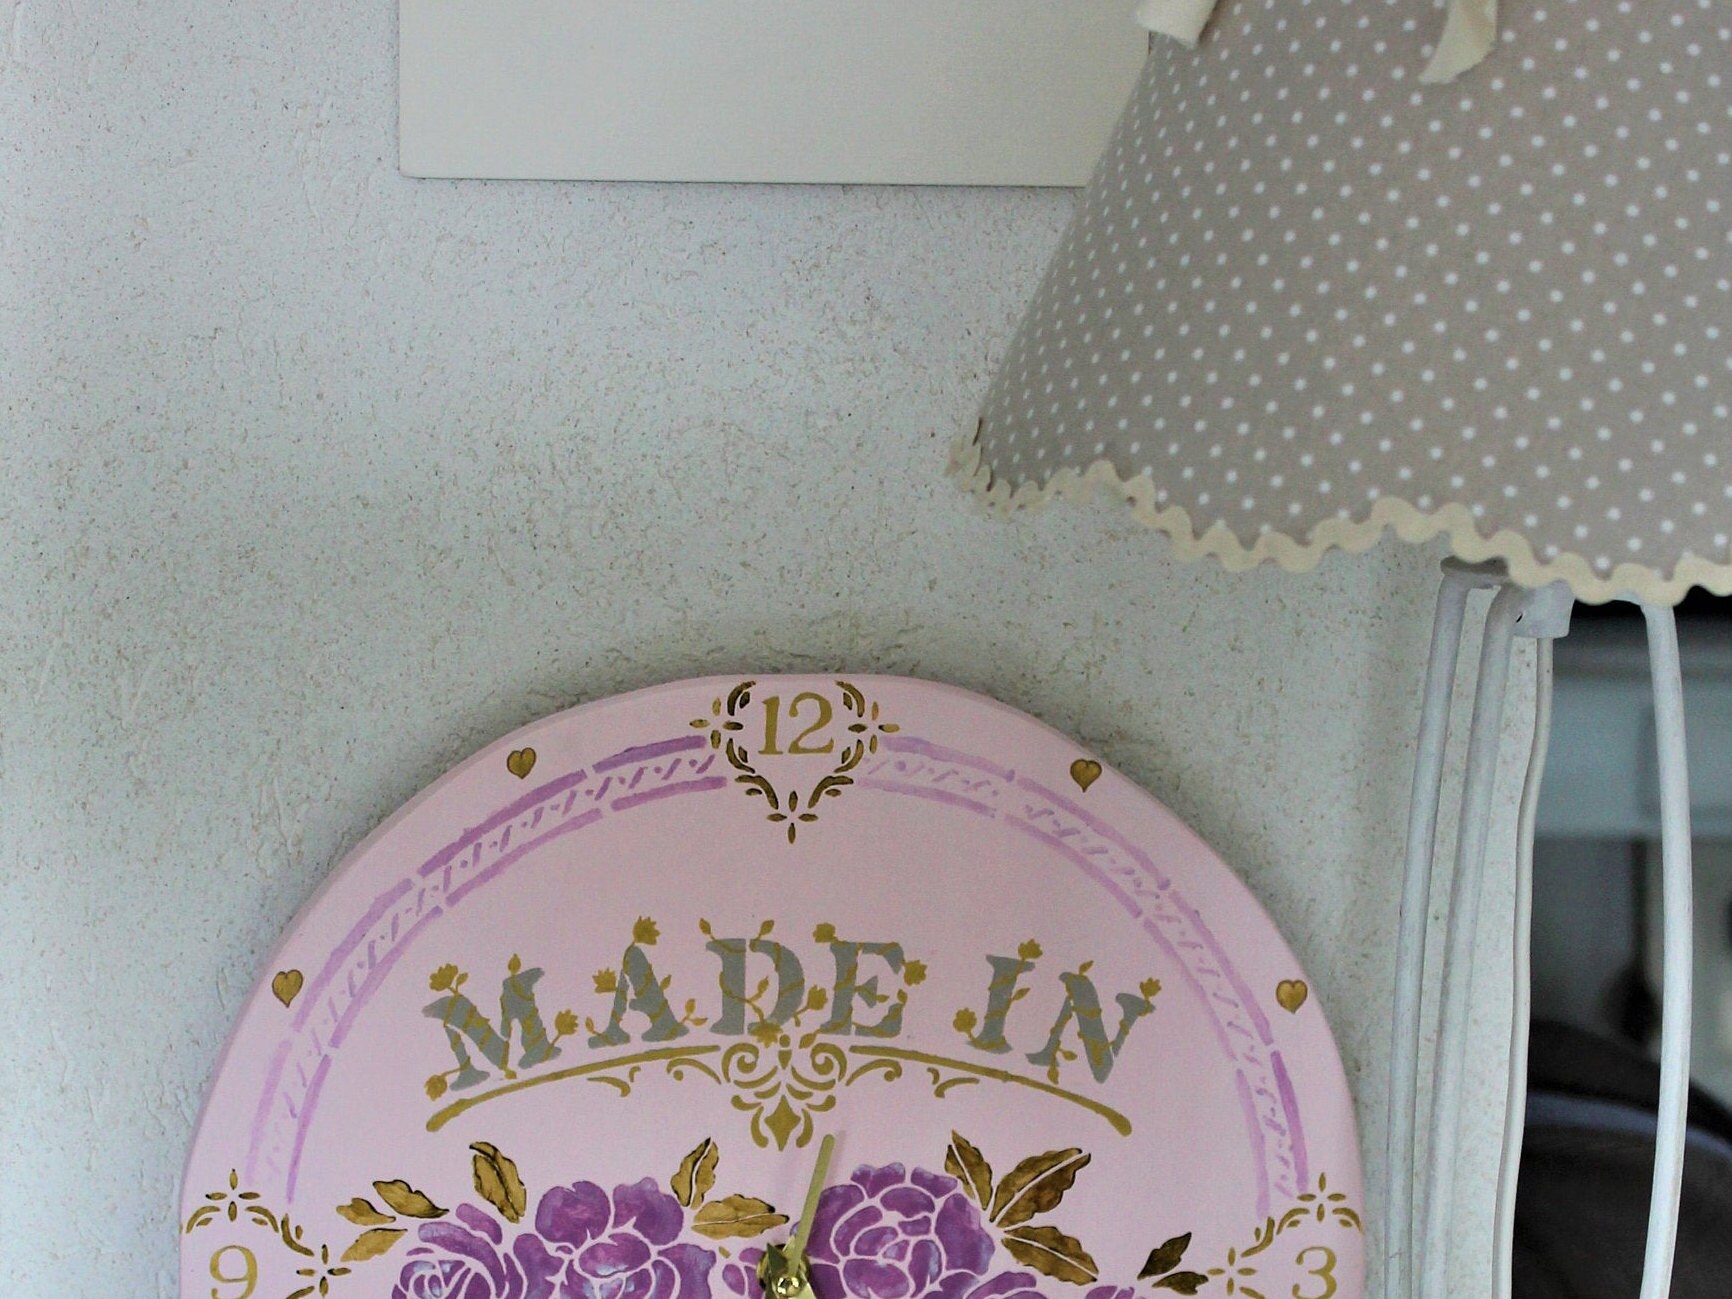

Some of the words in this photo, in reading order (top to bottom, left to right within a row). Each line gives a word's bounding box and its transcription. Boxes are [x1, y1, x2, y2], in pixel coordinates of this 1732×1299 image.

[758, 691, 834, 755] 12
[420, 934, 909, 1092] MADE
[968, 953, 1158, 1084] IN
